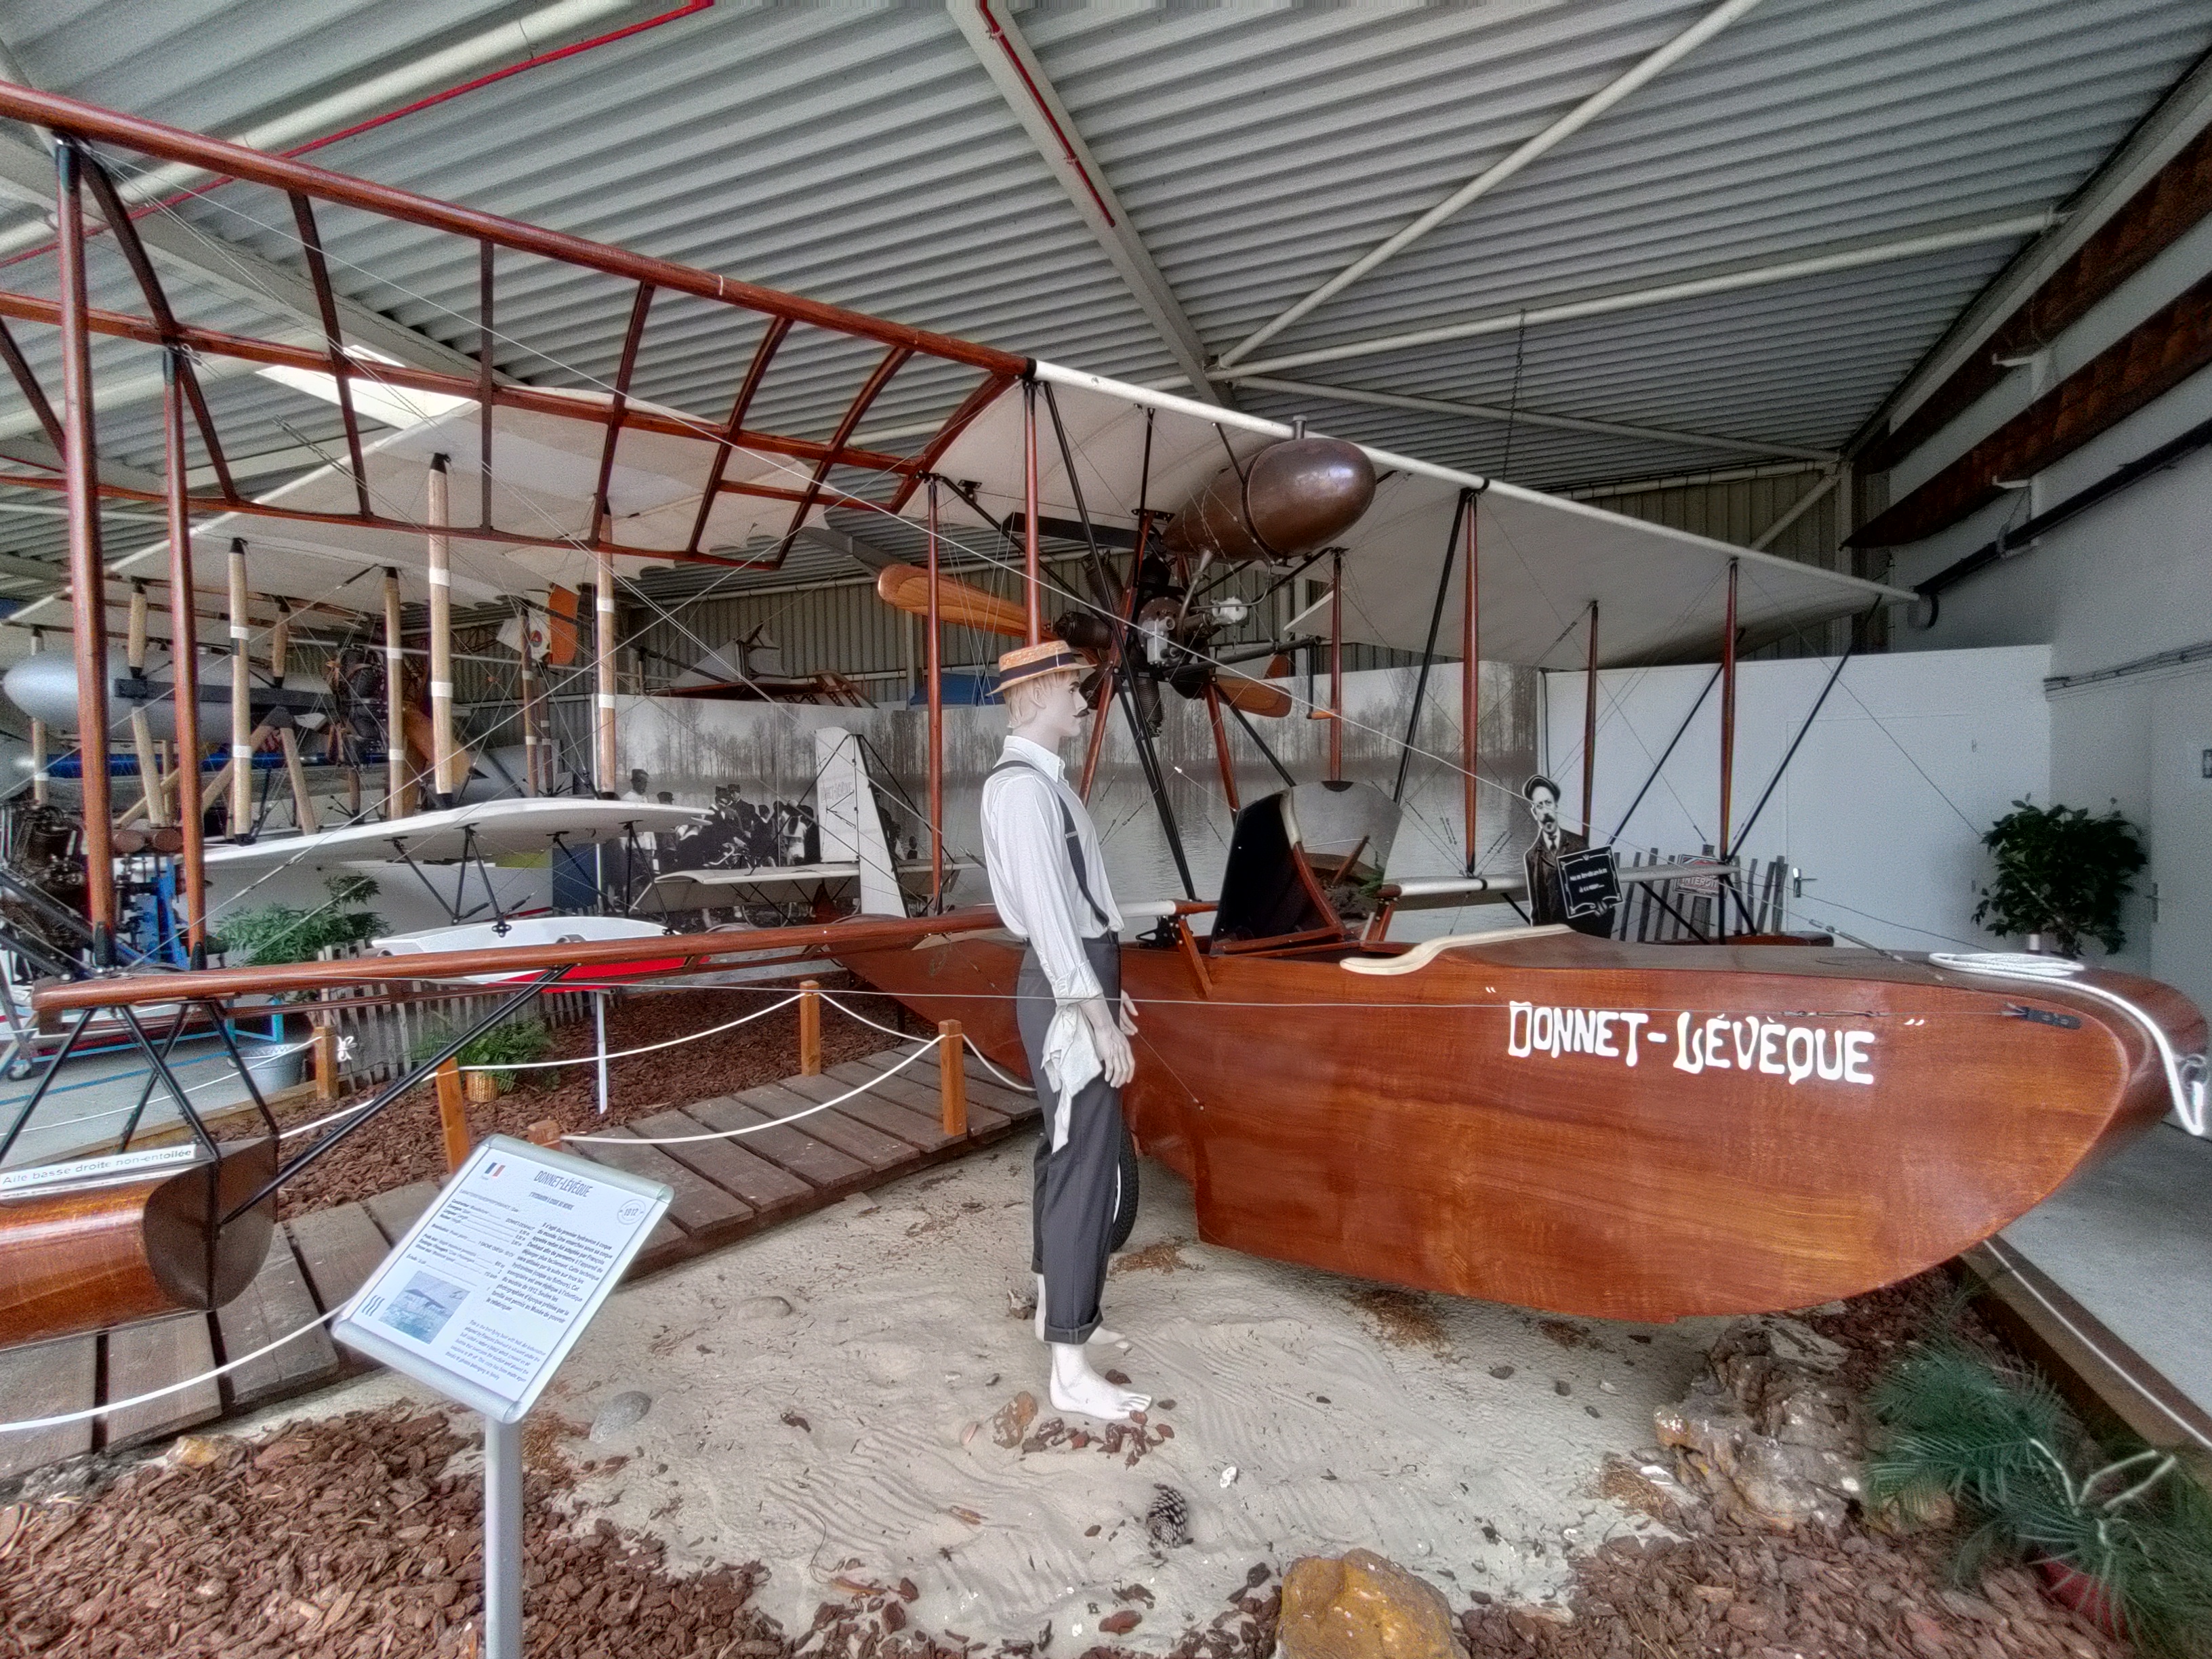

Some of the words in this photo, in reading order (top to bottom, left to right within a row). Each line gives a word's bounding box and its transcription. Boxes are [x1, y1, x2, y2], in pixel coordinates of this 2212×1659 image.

[3, 1175, 27, 1185] Aile
[33, 1168, 71, 1179] basse
[75, 1161, 111, 1172] droite
[116, 1149, 192, 1166] non-entoilée
[533, 1170, 593, 1197] DONNET-LÉVÊQUE
[623, 1208, 638, 1216] 1912
